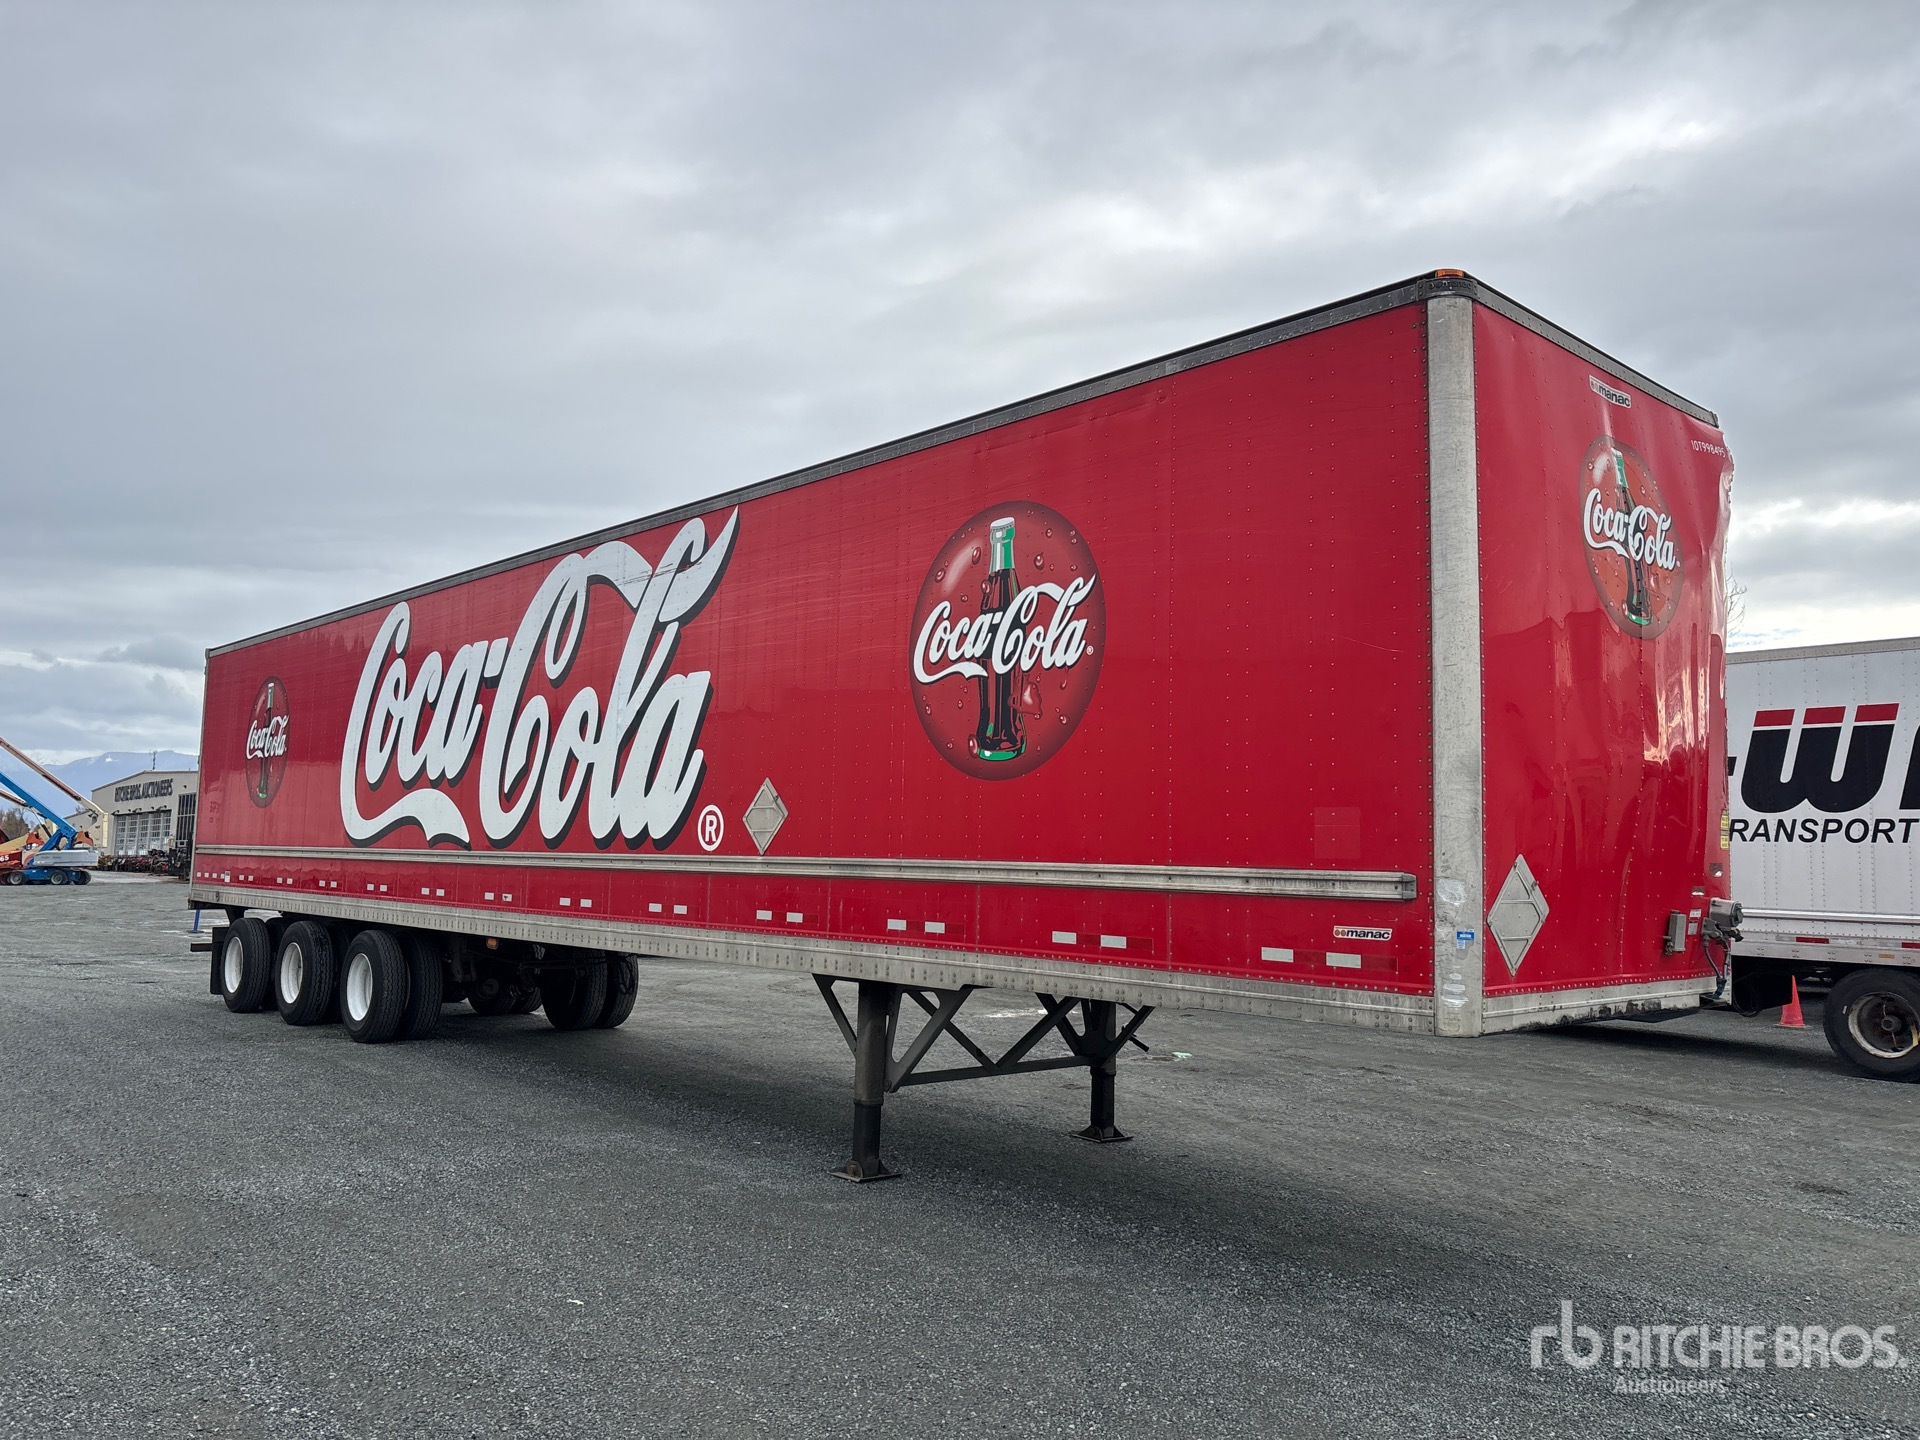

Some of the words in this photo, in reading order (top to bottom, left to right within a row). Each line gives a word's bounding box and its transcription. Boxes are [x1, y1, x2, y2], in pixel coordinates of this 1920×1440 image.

[1599, 385, 1630, 407] manac
[1583, 488, 1676, 570] Coca-Cola
[913, 573, 1096, 684] Coca-Cola
[340, 505, 739, 851] Coca-Cola
[246, 715, 289, 760] Coca-Cola
[1729, 818, 1919, 843] RANSPORT
[1346, 928, 1390, 940] manac
